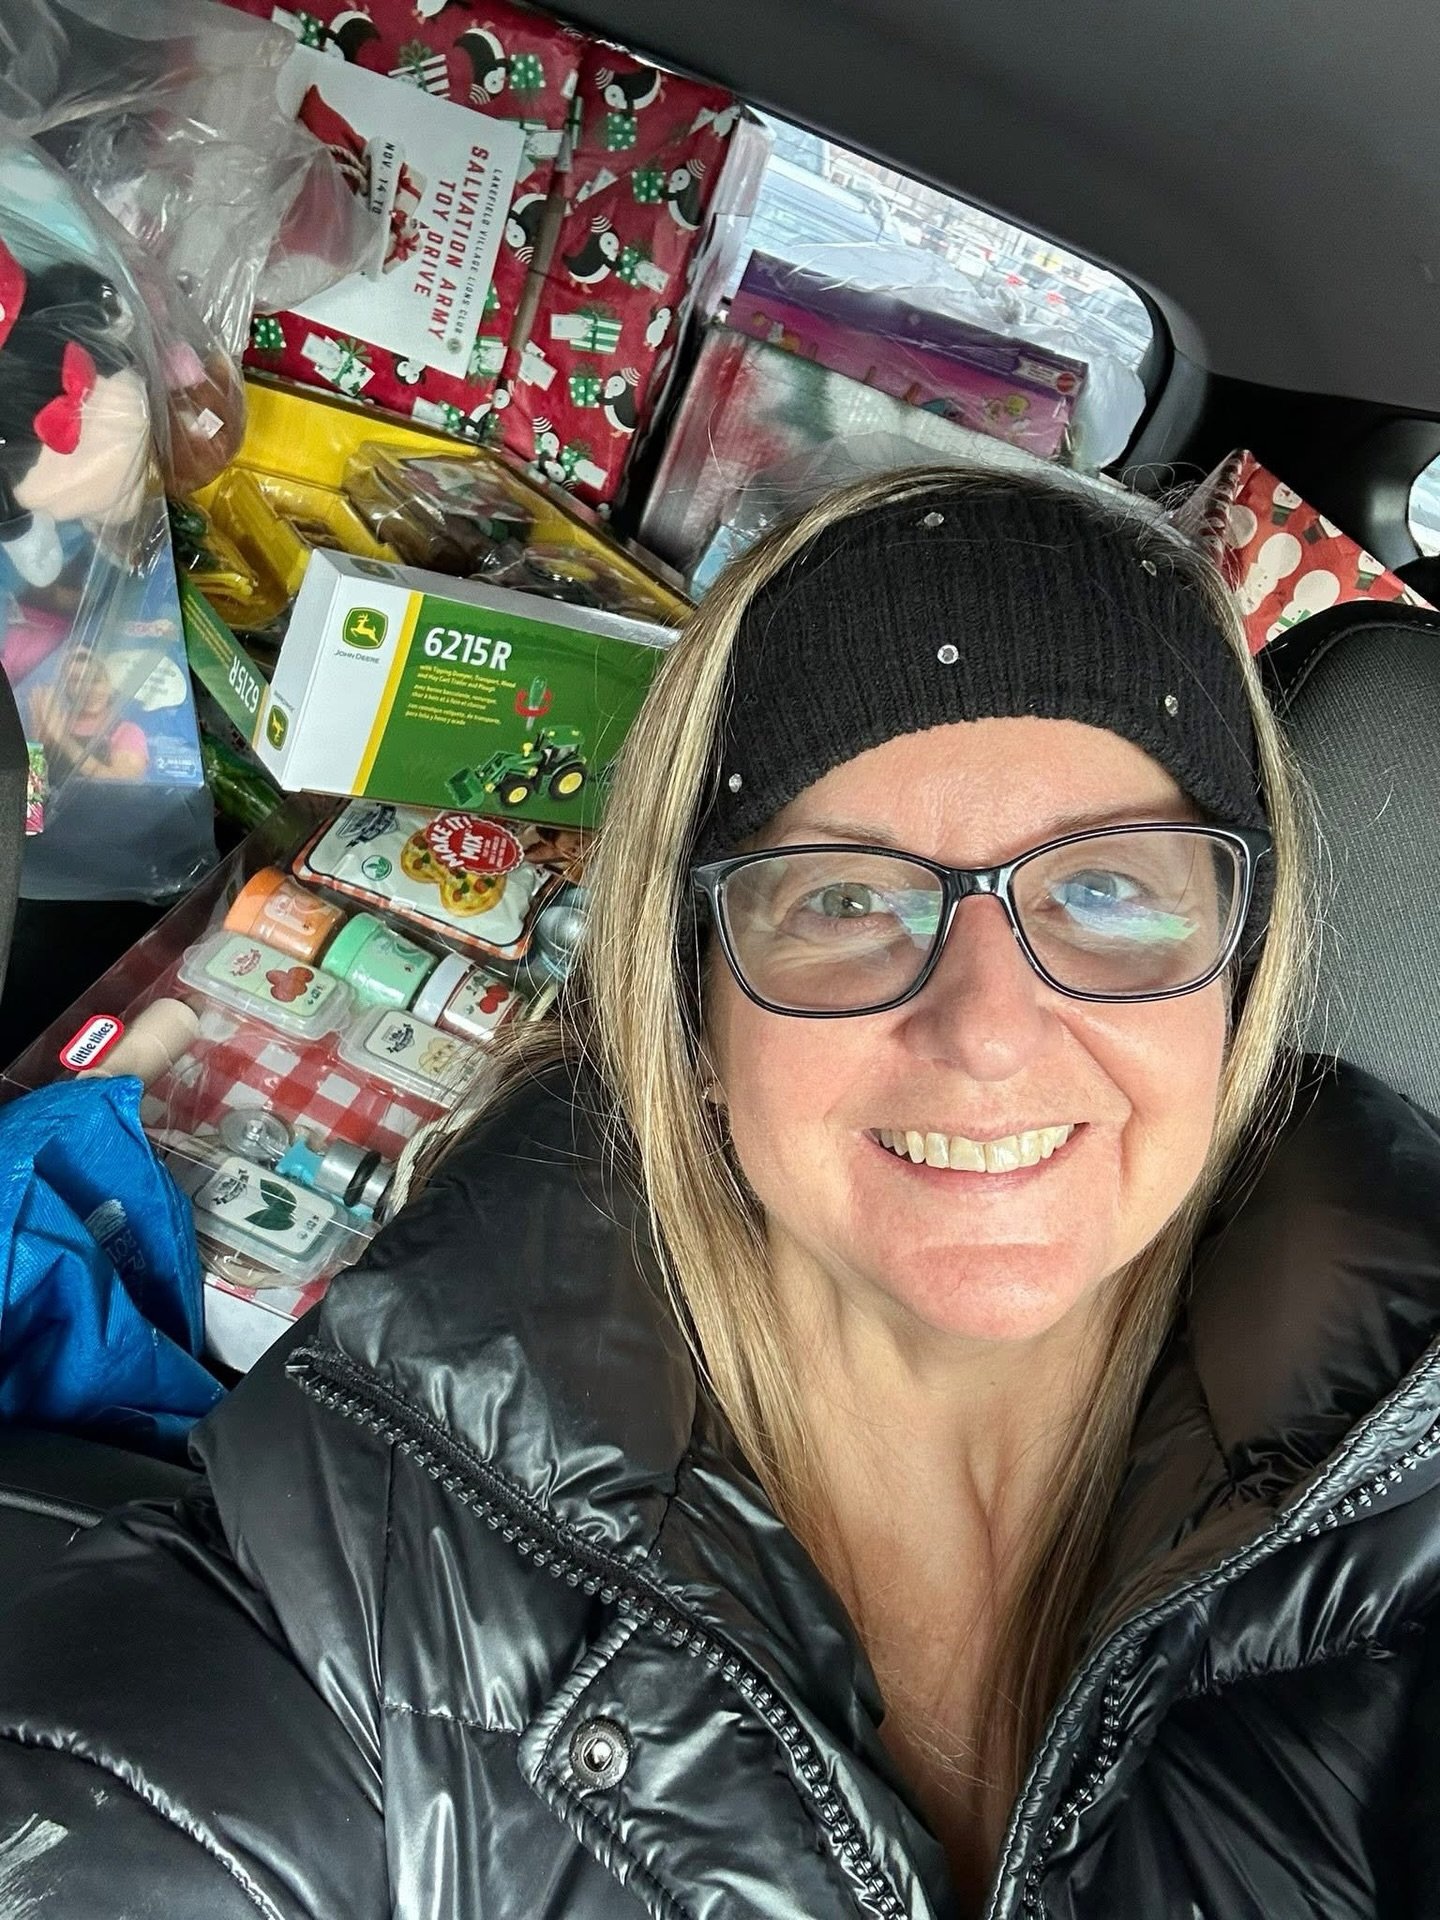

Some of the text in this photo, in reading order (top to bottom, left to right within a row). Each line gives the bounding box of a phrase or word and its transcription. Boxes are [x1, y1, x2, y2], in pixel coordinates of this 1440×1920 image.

[372, 142, 396, 215] NOV. 14 TO
[413, 179, 457, 298] TOY DRIVE
[427, 145, 490, 341] SALVATION ARMY
[454, 168, 503, 335] LAKEFIELD VILLAGE LIONS CLUB
[334, 649, 380, 664] JOHN DEERE
[424, 626, 513, 671] 6215R
[229, 655, 260, 714] 6215R
[430, 815, 473, 868] MAKE IT!
[459, 832, 484, 861] MIX
[70, 1022, 114, 1064] little tikes
